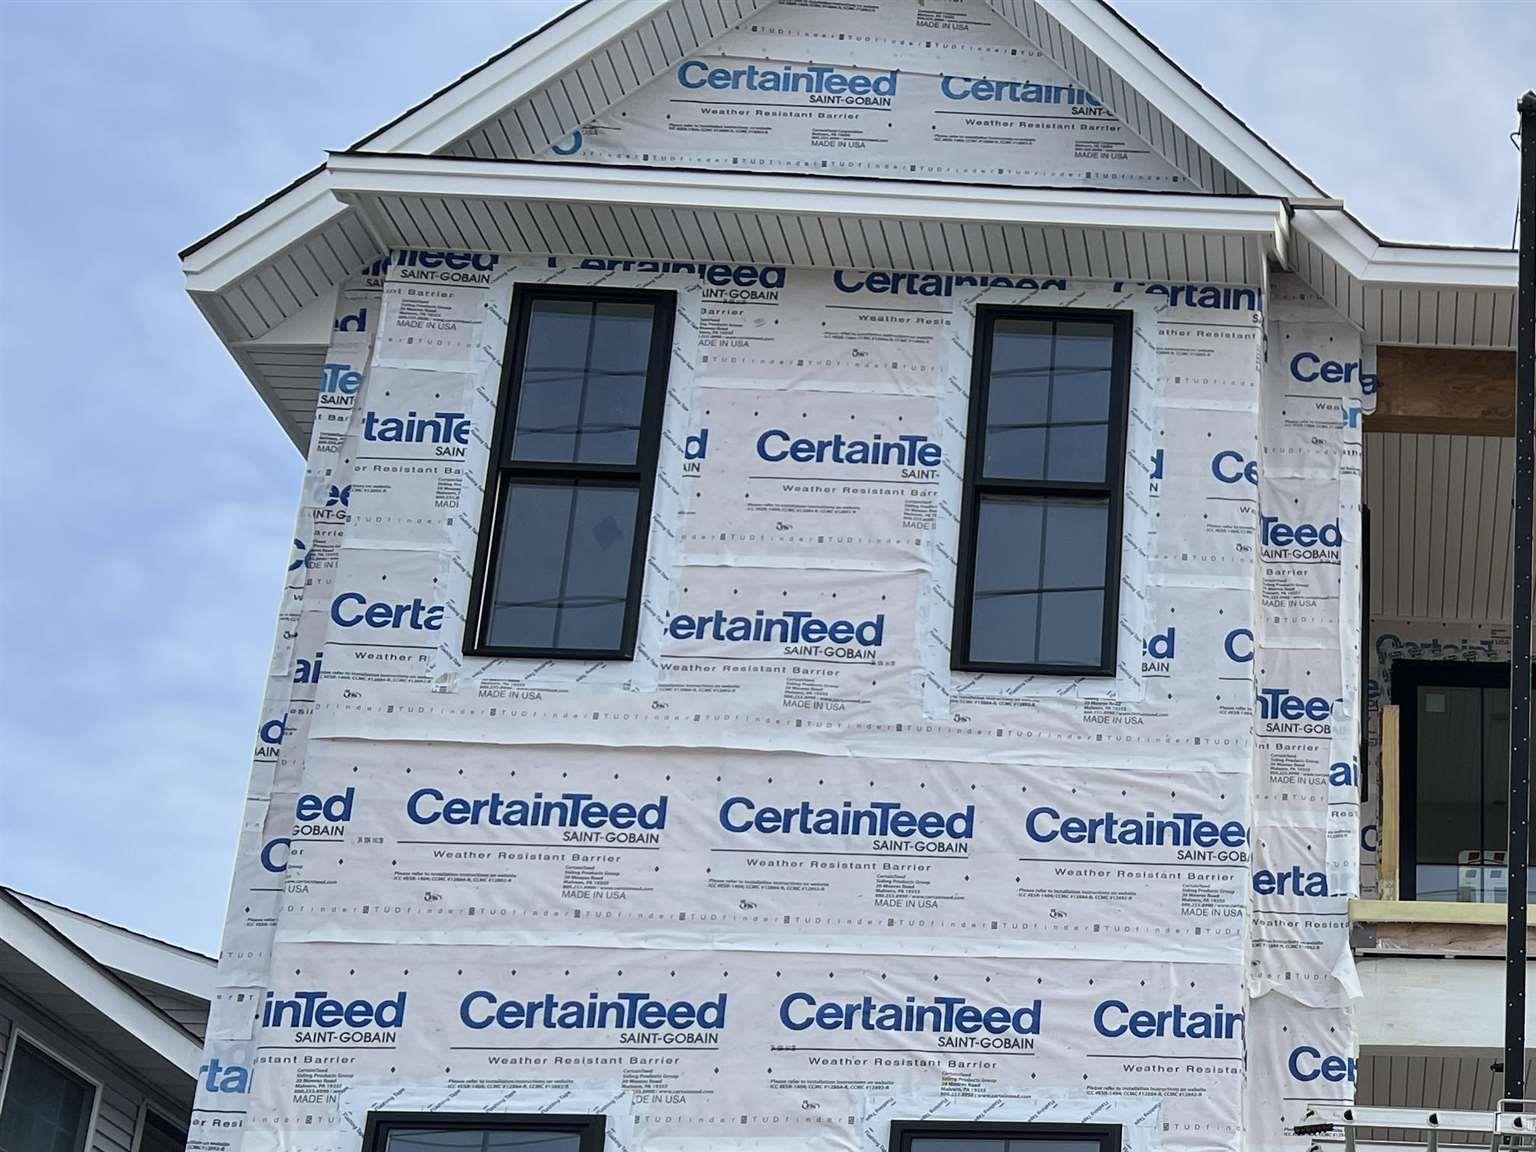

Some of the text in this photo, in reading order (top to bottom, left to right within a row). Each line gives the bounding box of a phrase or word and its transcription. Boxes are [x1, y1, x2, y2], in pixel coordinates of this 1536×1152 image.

[678, 61, 897, 96] CertainTeed
[809, 95, 891, 106] SAINT-GOBAIN
[701, 107, 860, 120] Weather Resistant Barrier
[965, 119, 1121, 132] Weather Resistant Barrier
[400, 269, 490, 284] SAINT-GOBAIN
[397, 319, 422, 328] MADE
[438, 322, 457, 331] USA
[783, 484, 836, 493] Weather
[664, 610, 884, 646] ertainTeed
[354, 652, 412, 662] Weather
[784, 646, 876, 659] SAINT-GOBAIN
[660, 664, 840, 676] Weather Barrier
[478, 690, 542, 700] MADE IN USA
[1083, 715, 1144, 725] MADE IN USA
[1276, 743, 1319, 751] Barrier
[407, 788, 668, 830] CertainTeed
[720, 796, 975, 838] CertainTeed
[1025, 807, 1250, 847] CertainTee
[563, 832, 659, 843] SAINT-GOBAIN
[873, 840, 968, 852] SAINT-GOBAIN
[434, 850, 621, 862] Weather Resistant Barrier
[747, 858, 932, 871] Weather Resistant Barrier
[1055, 867, 1234, 881] Weather Resistant Barrier
[562, 890, 626, 900] MADE IN USA
[874, 900, 938, 909] MADE IN USA
[1181, 908, 1242, 917] MADE IN USA
[460, 991, 727, 1031] CertainTeed
[780, 992, 1041, 1035] CertainTeed
[295, 1031, 396, 1043] SAINT-GOBAIN
[620, 1033, 718, 1044] SAINT-GOBAIN
[938, 1036, 1034, 1050] SAINT-GOBAIN
[304, 1055, 355, 1064] Barrier
[488, 1055, 680, 1065] Weather Resistant Barrier
[808, 1057, 998, 1070] Weather Resistant Barrier
[1123, 1064, 1182, 1074] Weather
[293, 1094, 323, 1104] MADE
[664, 1095, 686, 1104] USA
